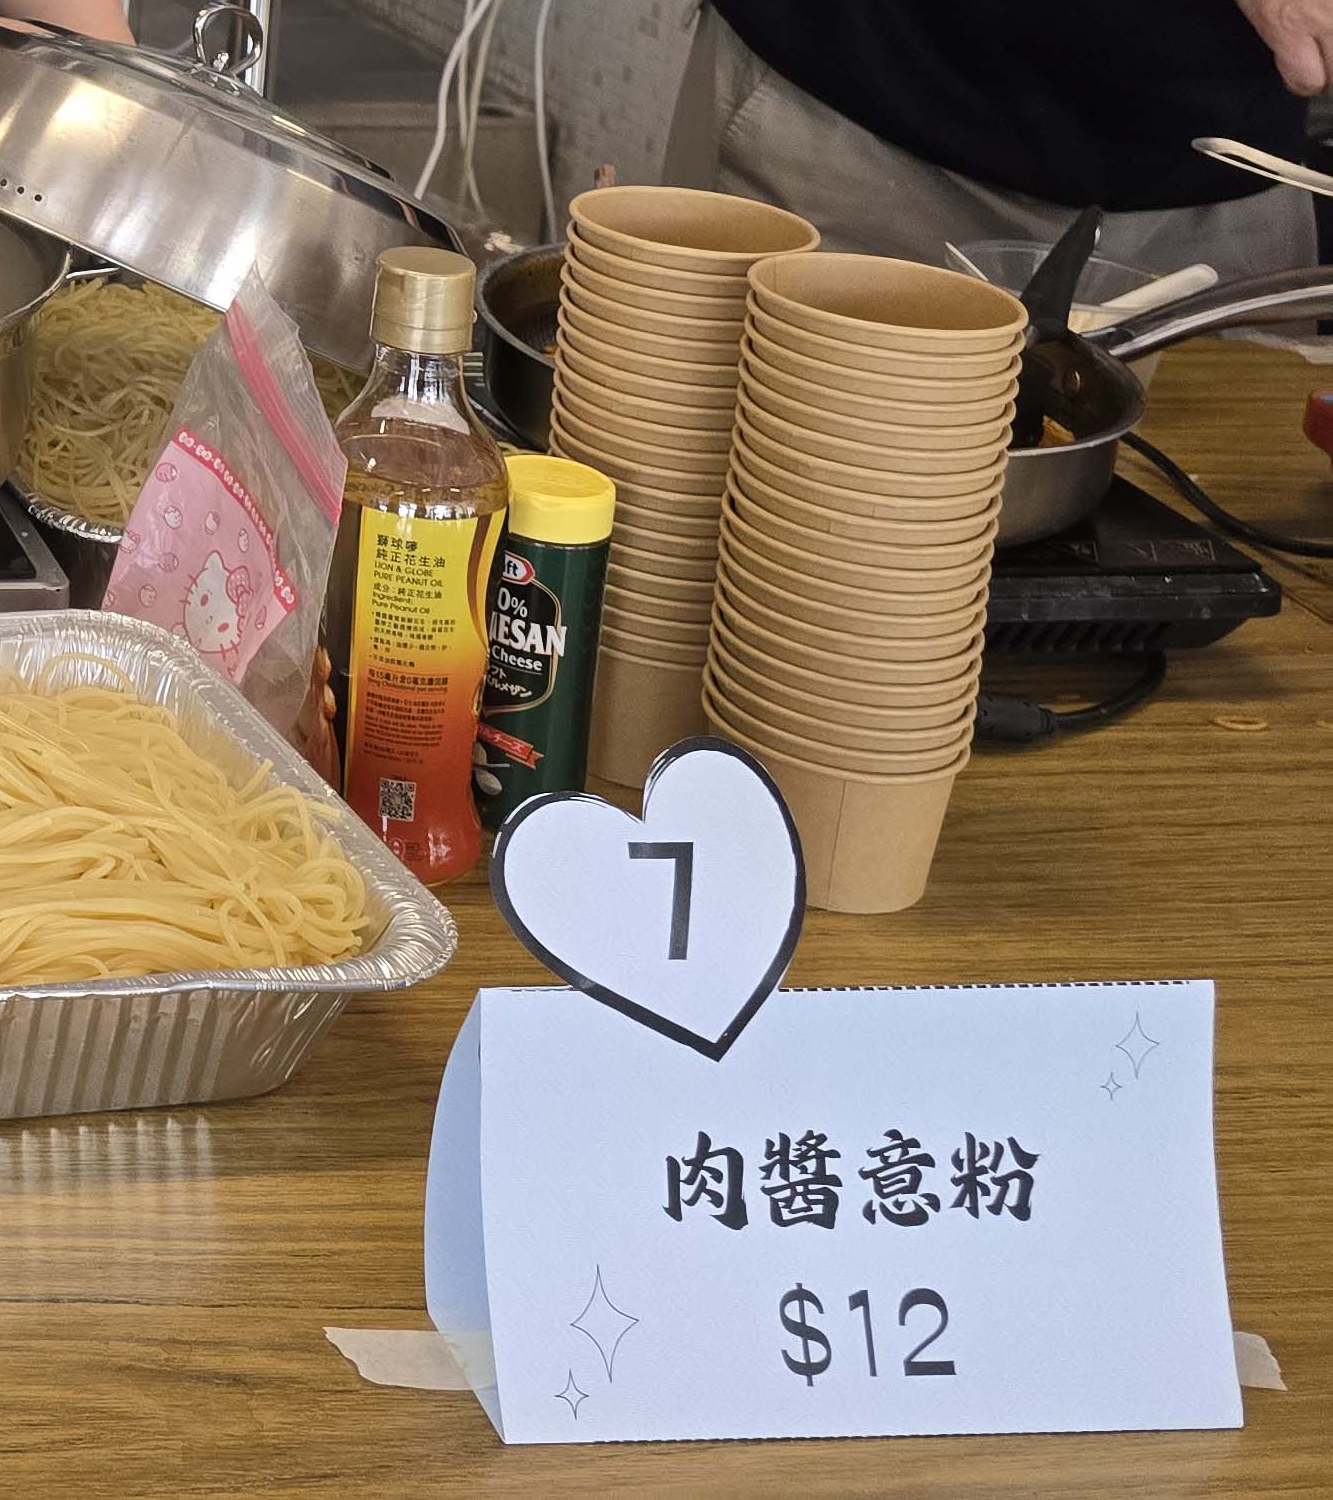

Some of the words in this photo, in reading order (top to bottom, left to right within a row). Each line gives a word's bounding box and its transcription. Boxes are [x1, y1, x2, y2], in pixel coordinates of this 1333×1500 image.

[374, 561, 394, 572] LION
[395, 564, 402, 572] &
[405, 567, 434, 577] GLOBE
[376, 548, 446, 568] 純正花生油
[374, 570, 393, 581] PURE
[395, 574, 428, 586] PEANUT
[497, 587, 528, 618] 0%
[488, 665, 507, 678] フト
[491, 644, 543, 672] Cheese
[627, 841, 695, 961] 7
[662, 1128, 1041, 1232] 肉醬意粉
[779, 1282, 958, 1388] $12
